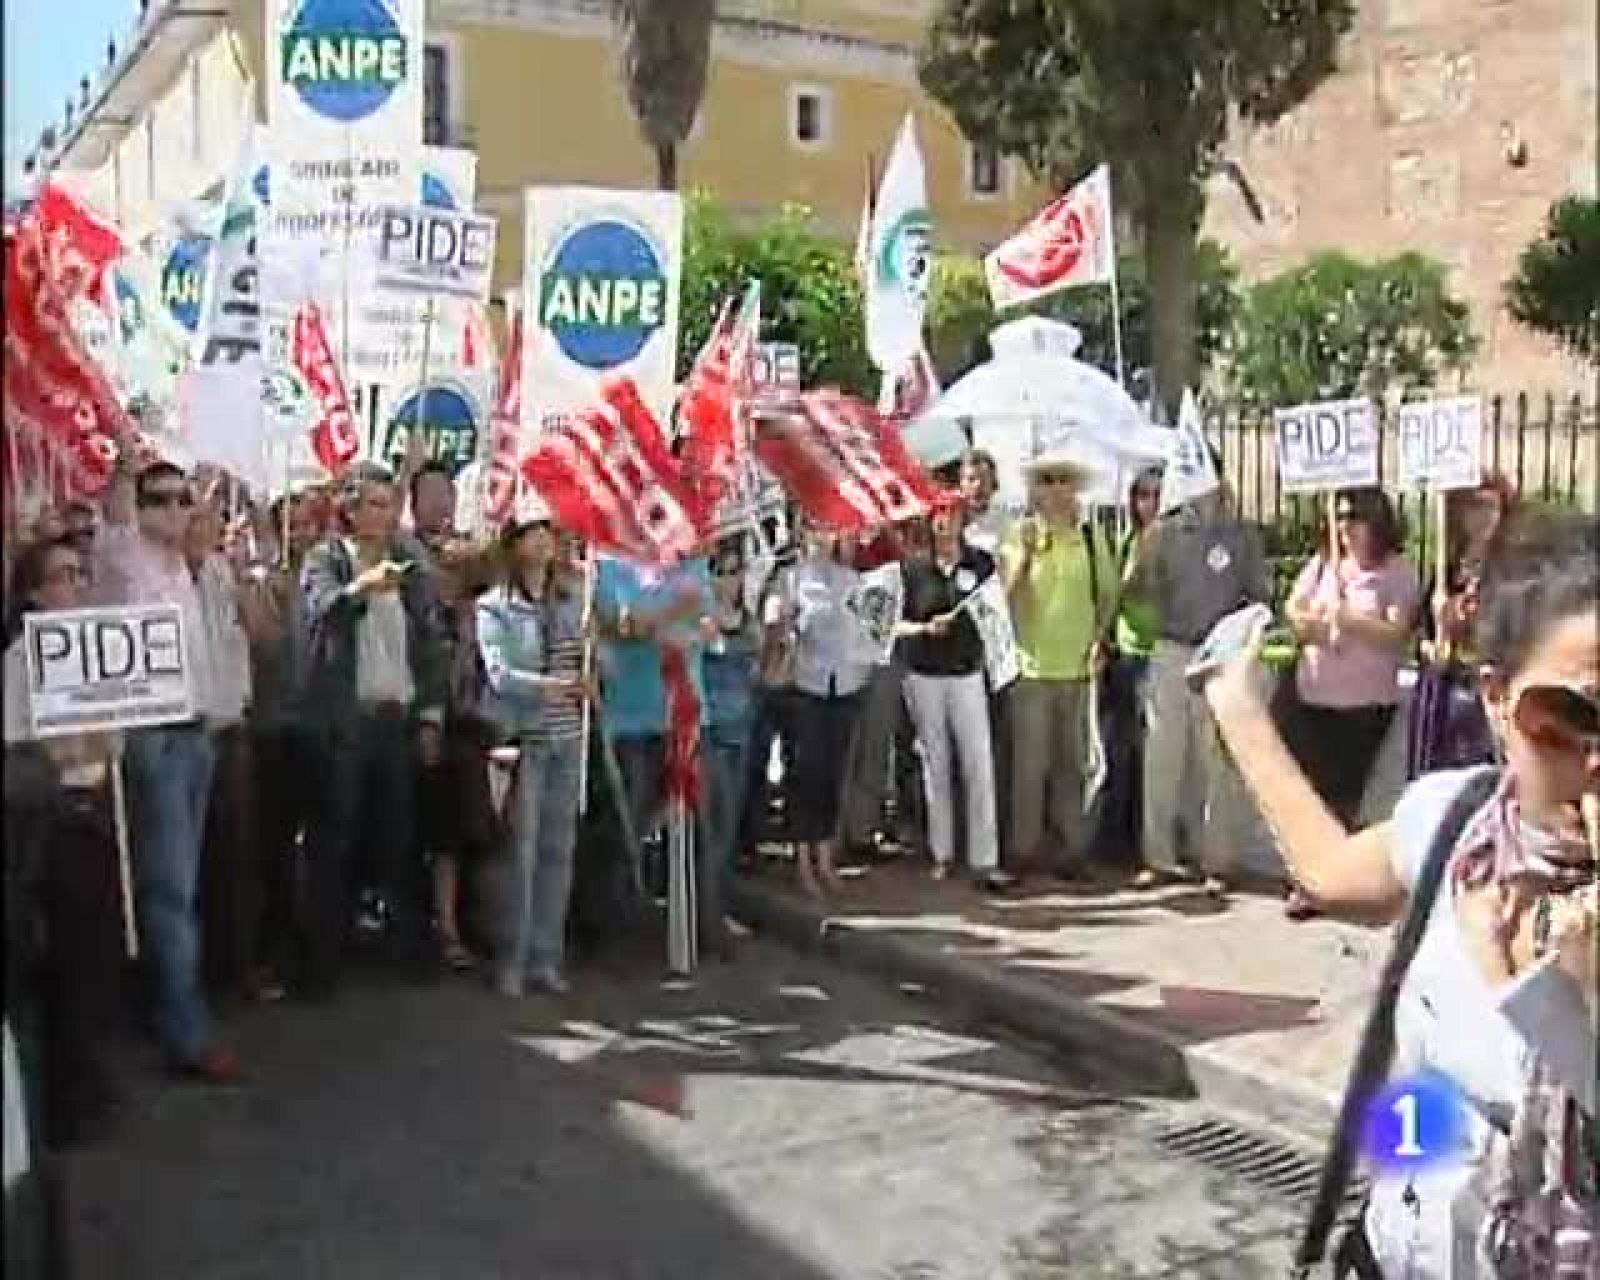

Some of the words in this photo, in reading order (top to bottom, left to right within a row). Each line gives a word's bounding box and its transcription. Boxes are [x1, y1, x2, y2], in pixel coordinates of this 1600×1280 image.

[288, 37, 403, 81] ANPE
[379, 210, 491, 267] PIDE
[165, 271, 199, 304] AN
[544, 276, 661, 325] ANPE
[1278, 408, 1364, 464] PIDE
[36, 616, 182, 686] PIDE
